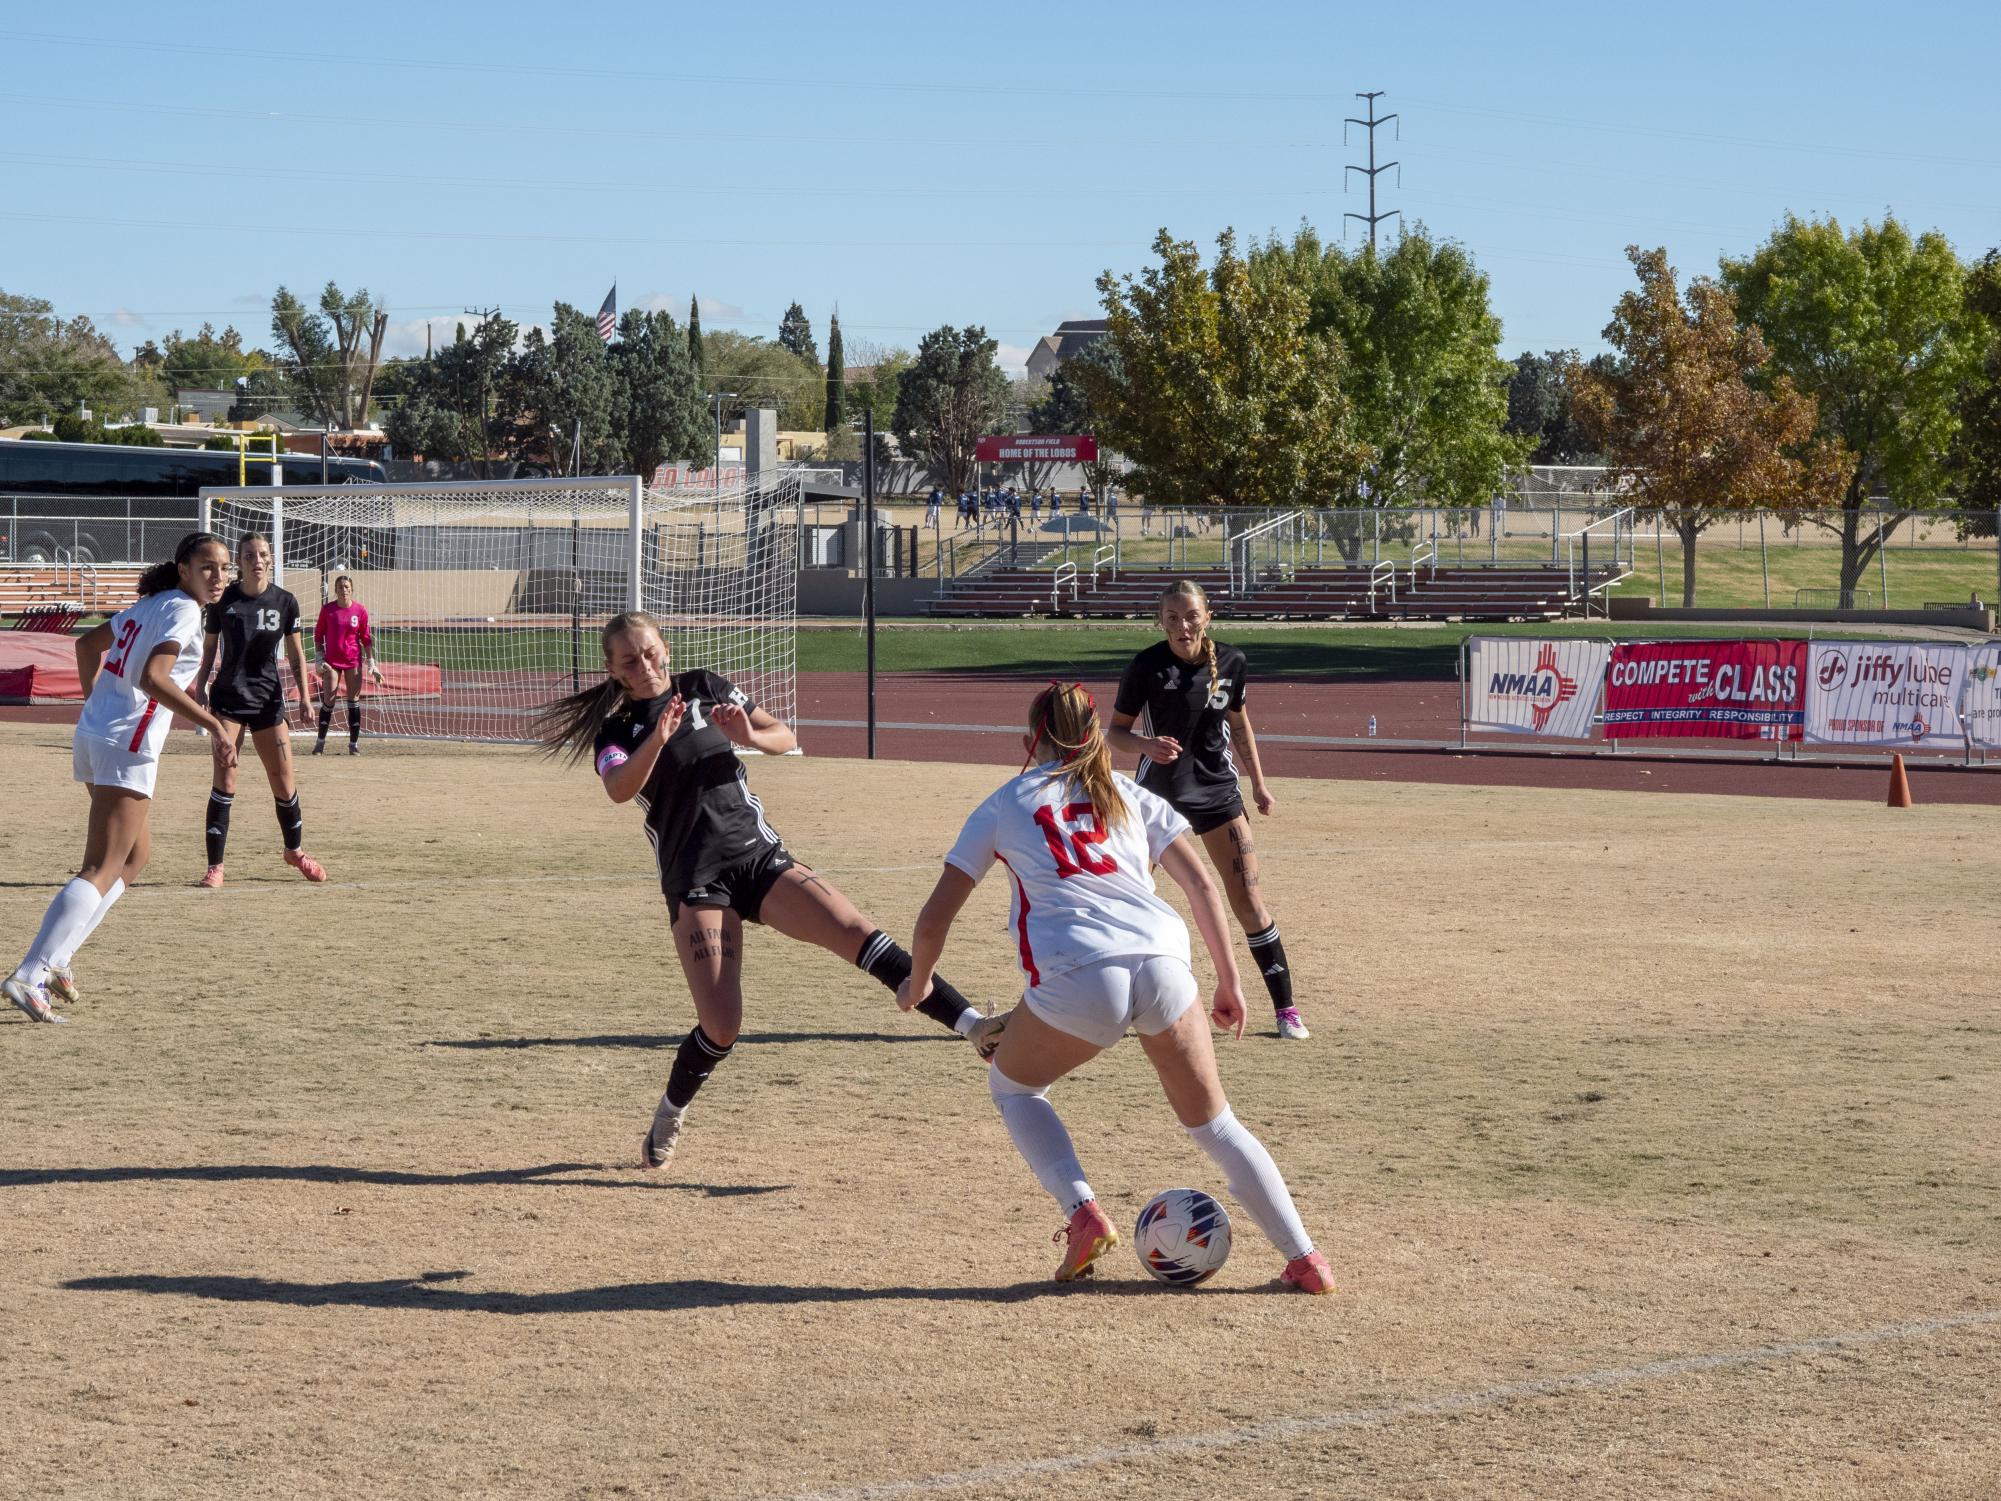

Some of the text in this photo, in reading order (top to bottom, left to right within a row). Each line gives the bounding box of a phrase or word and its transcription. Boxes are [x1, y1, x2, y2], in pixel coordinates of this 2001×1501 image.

[999, 448, 1077, 458] HOME OF THE LOBOS
[256, 608, 281, 632] 13
[350, 615, 359, 628] 9
[104, 618, 143, 678] 21
[1489, 672, 1553, 696] NMAA
[1612, 659, 1711, 687] COMPETE
[1714, 663, 1797, 703] CLASS
[1850, 655, 1904, 689] jiffy
[1906, 656, 1952, 686] lube
[728, 686, 749, 708] H
[1687, 679, 1715, 704] with
[1604, 710, 1794, 723] RESPECT INTEGRITY RESPONSIBILITY
[1847, 719, 1876, 732] SPONSOR
[1892, 722, 1922, 732] NMAA
[1032, 802, 1119, 880] 12
